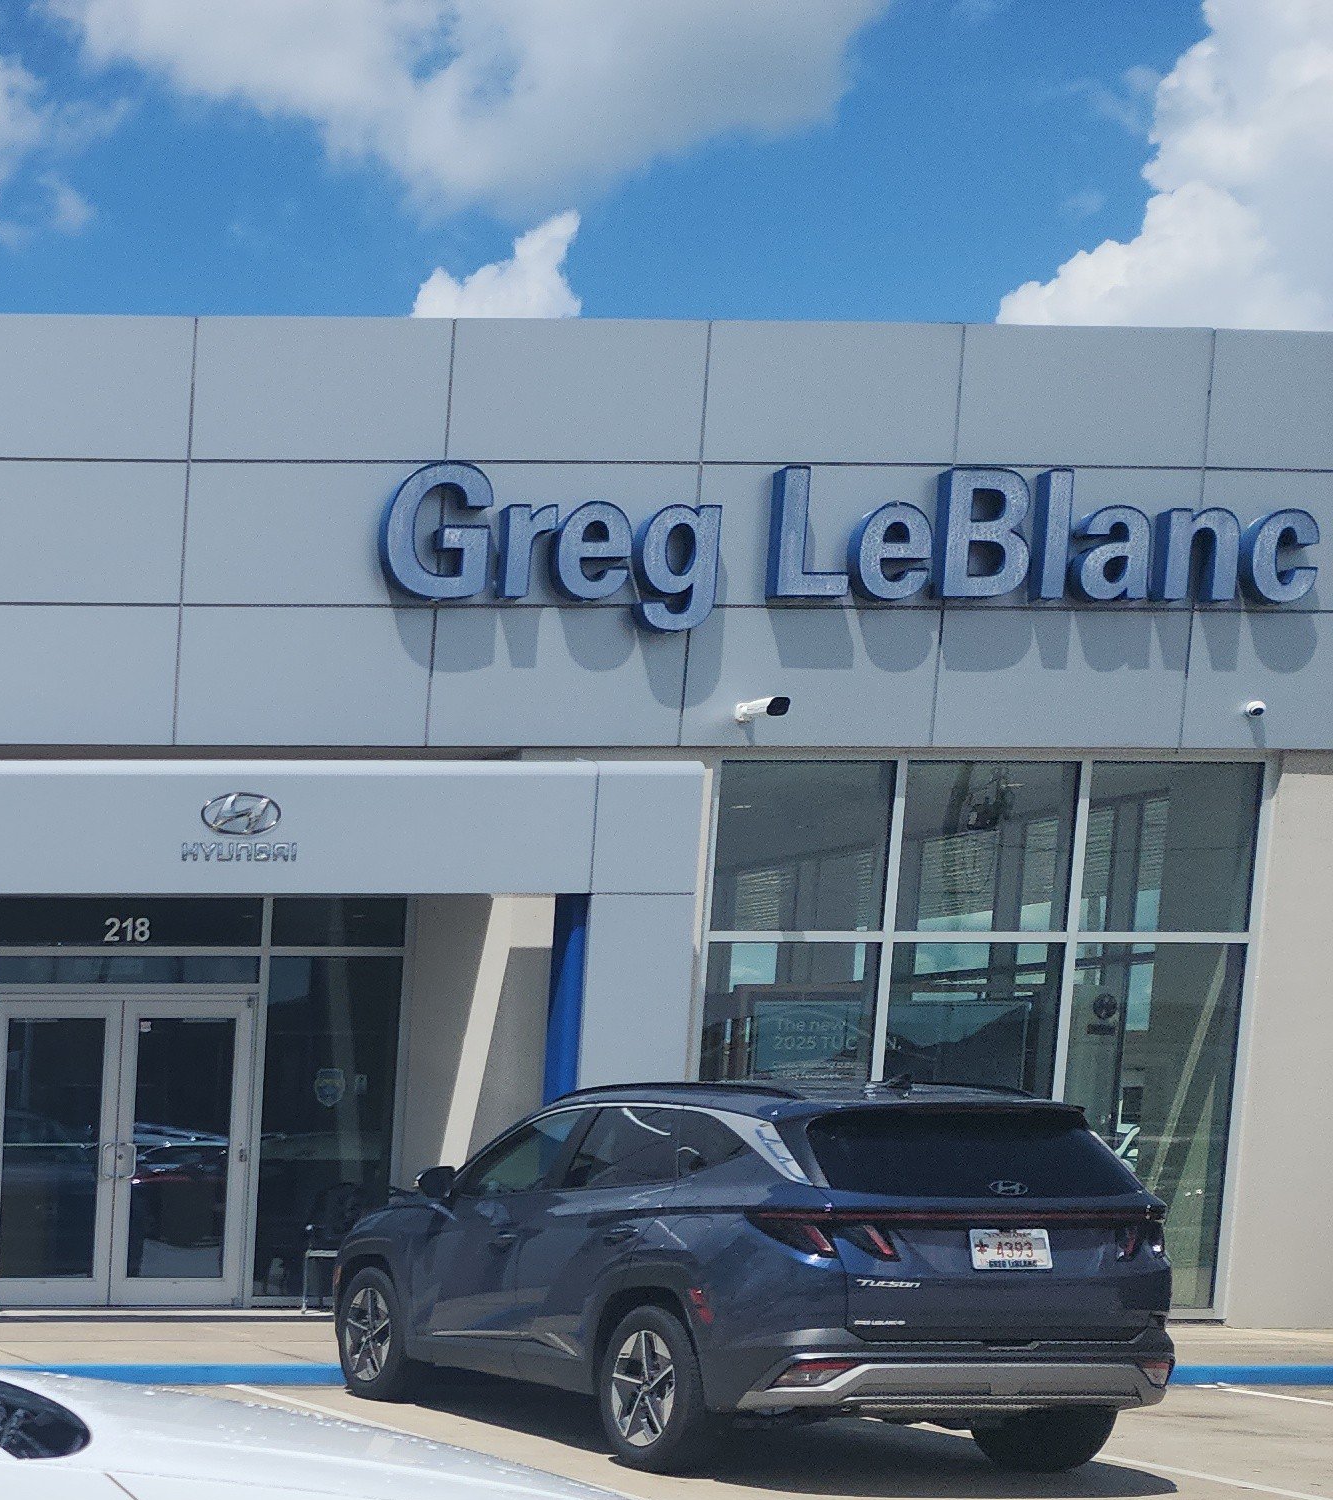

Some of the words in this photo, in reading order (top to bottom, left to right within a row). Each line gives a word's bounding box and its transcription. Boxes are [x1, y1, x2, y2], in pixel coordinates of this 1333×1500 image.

[378, 460, 723, 632] Greg
[764, 464, 1321, 604] LeBlanc
[180, 842, 299, 862] HYUNDAI
[104, 917, 151, 942] 218
[773, 1035, 817, 1051] 2025
[996, 1241, 1034, 1258] 4393
